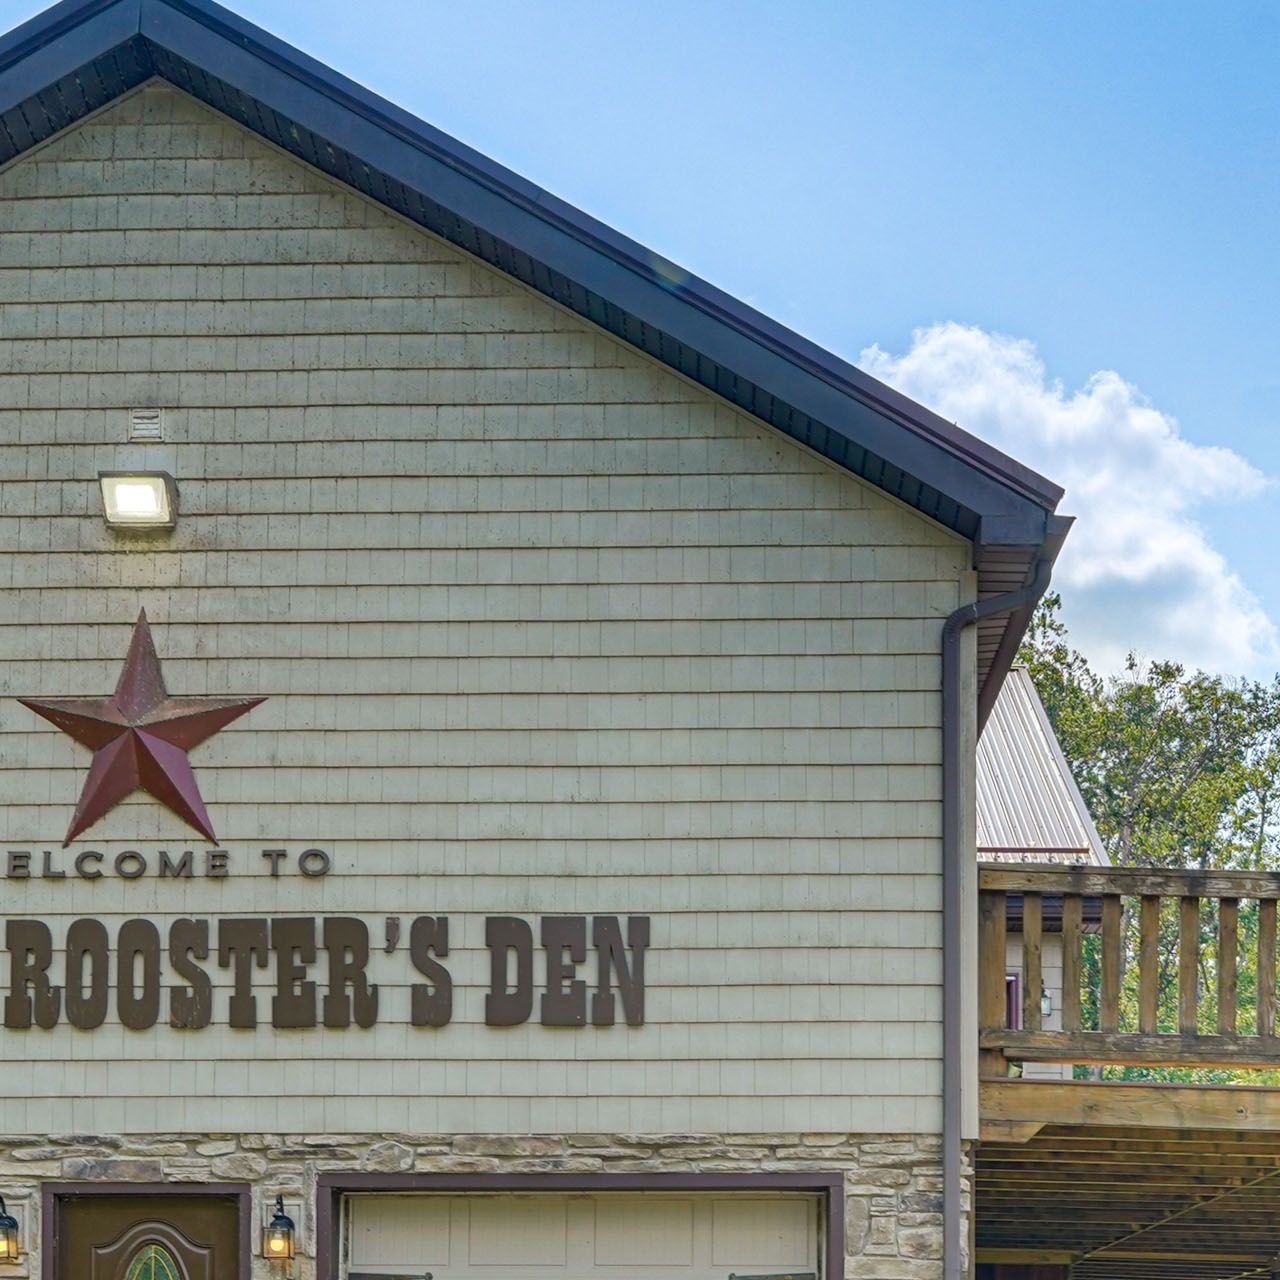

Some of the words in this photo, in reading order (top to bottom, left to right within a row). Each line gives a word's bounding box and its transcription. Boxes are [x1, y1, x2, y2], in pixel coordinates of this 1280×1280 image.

[261, 848, 329, 878] TO
[4, 915, 453, 1030] ROOSTER'S
[484, 916, 652, 1027] DEN
